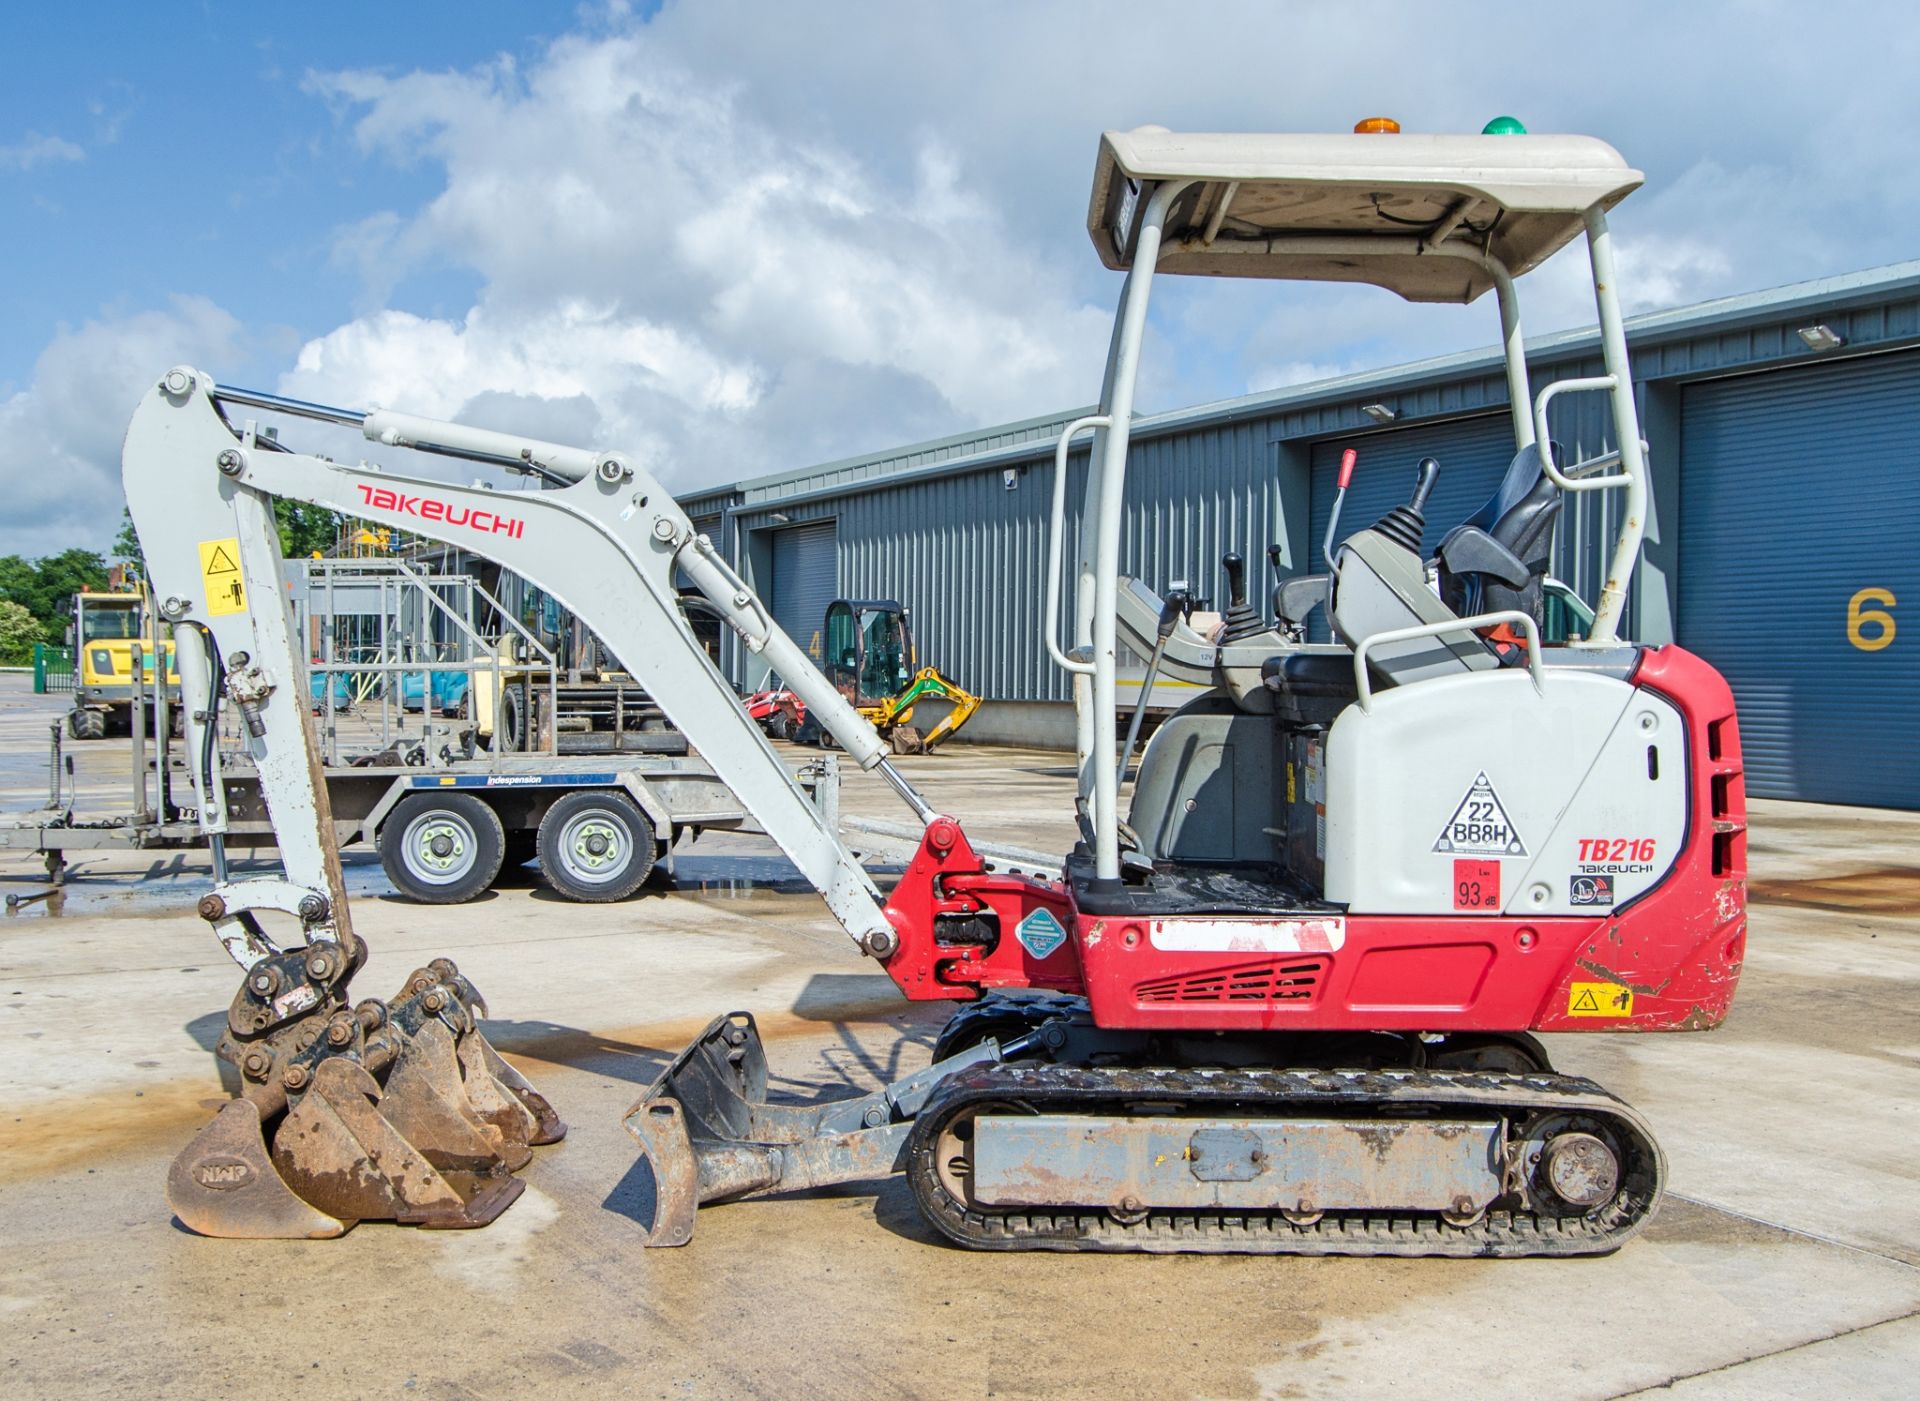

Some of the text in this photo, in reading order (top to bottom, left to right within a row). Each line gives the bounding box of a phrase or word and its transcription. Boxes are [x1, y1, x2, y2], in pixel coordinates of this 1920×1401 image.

[1847, 587, 1897, 652] 6
[808, 631, 820, 660] 4
[1468, 801, 1495, 822] 22
[1453, 823, 1507, 845] BB8H
[1578, 838, 1656, 862] TB216
[1459, 881, 1497, 906] 93 dB
